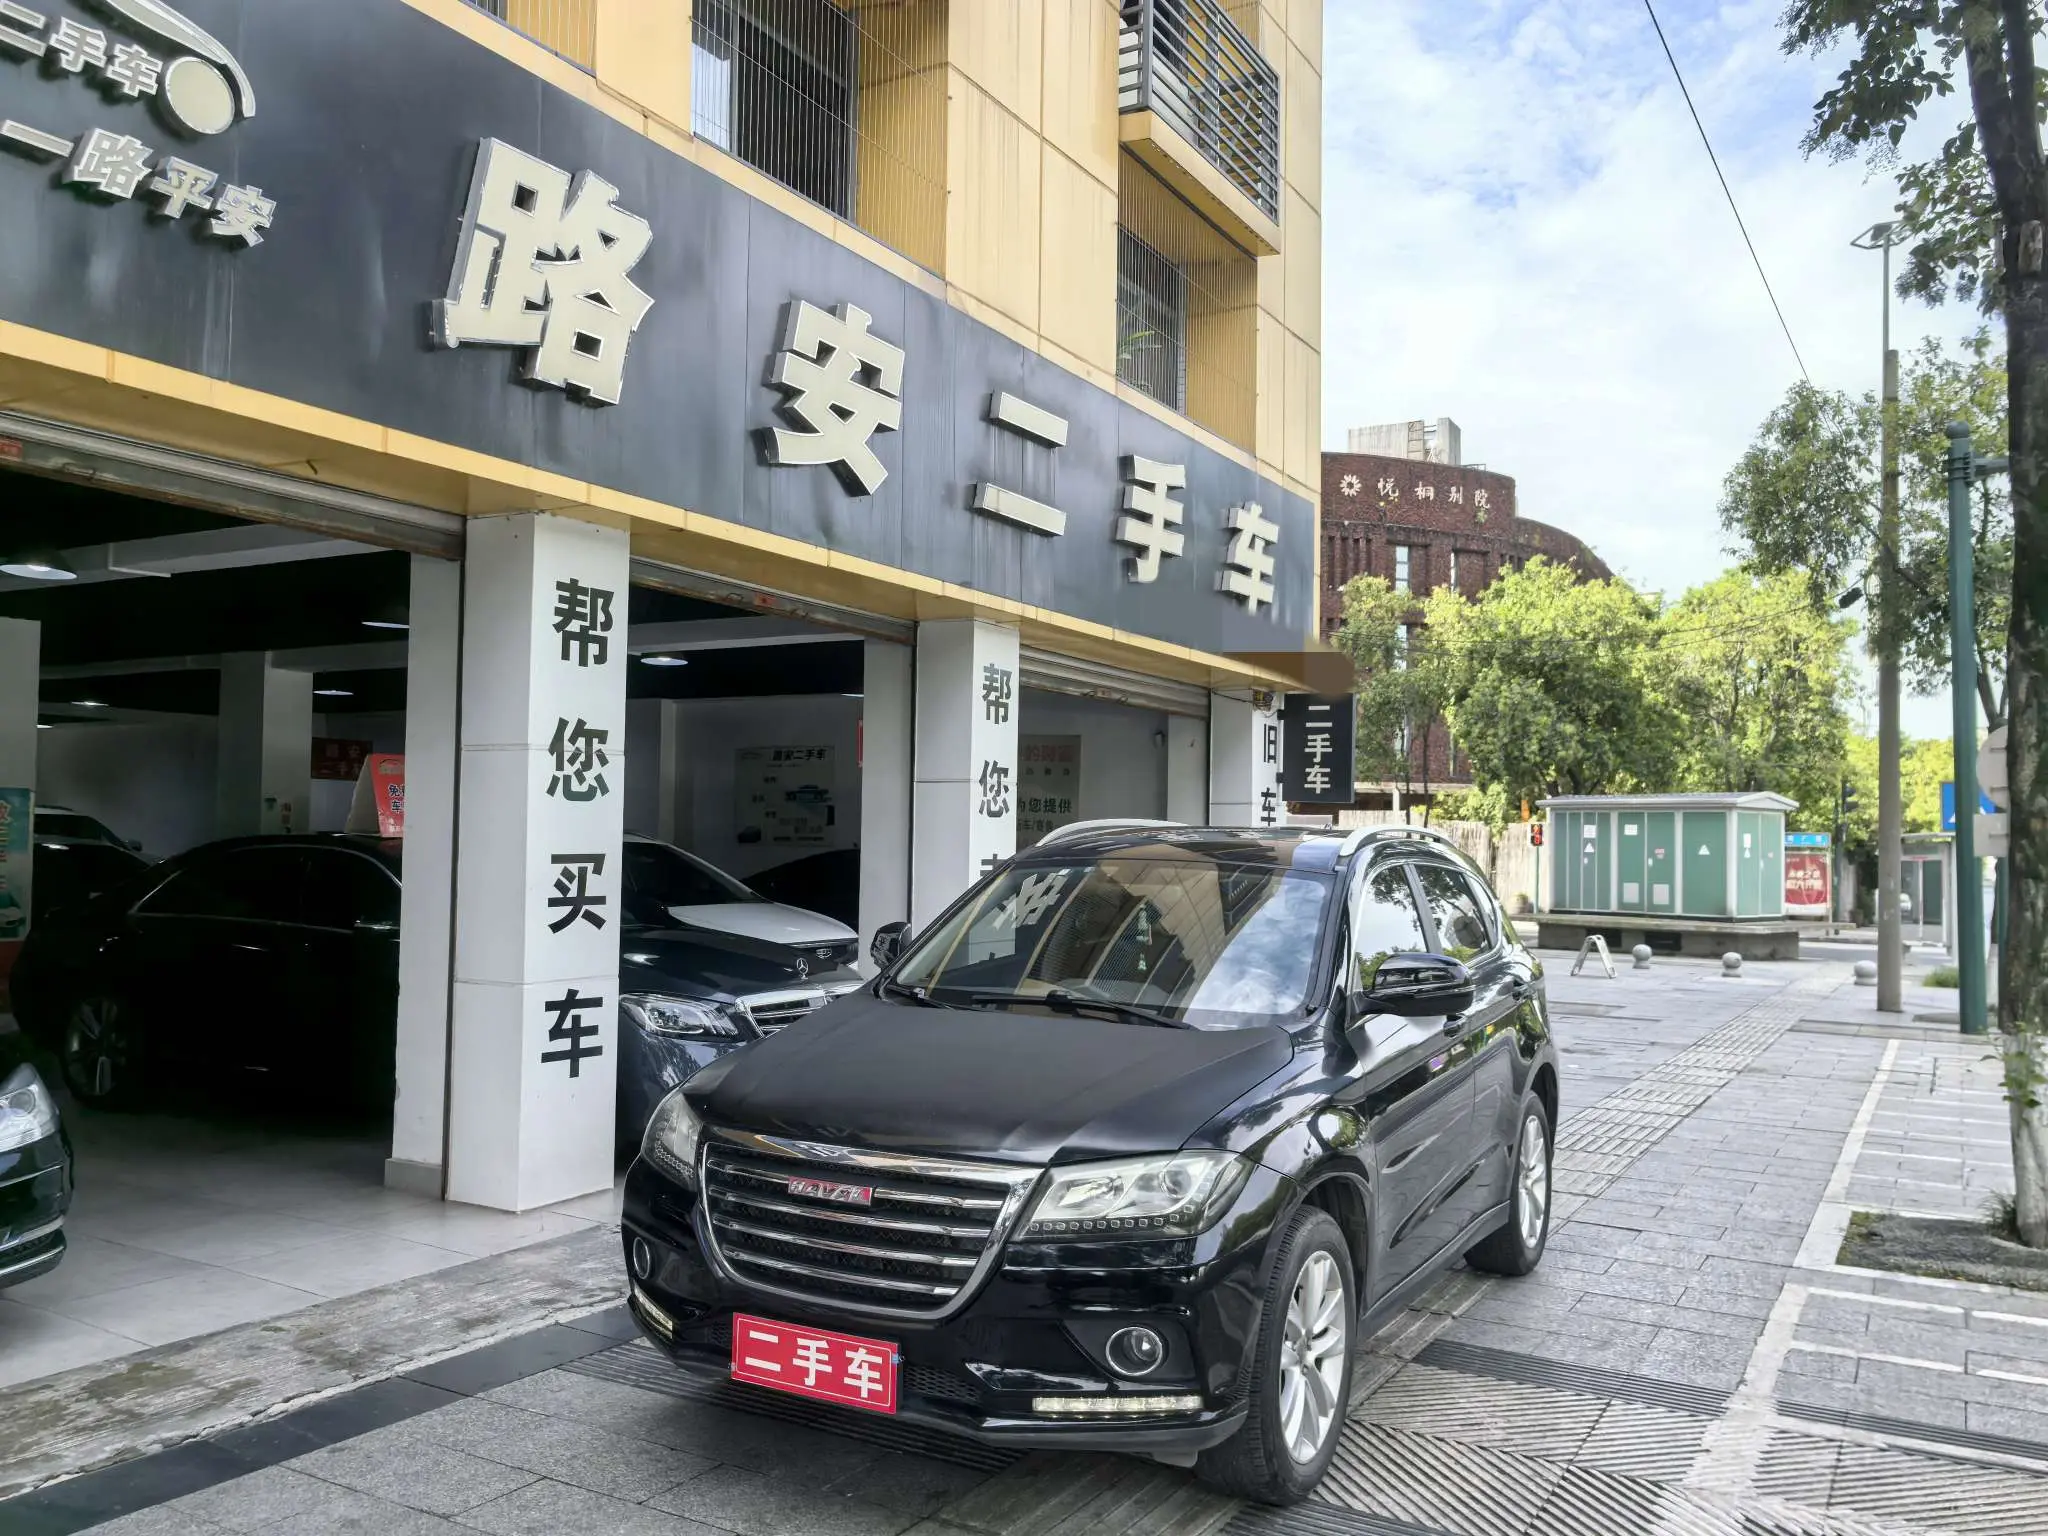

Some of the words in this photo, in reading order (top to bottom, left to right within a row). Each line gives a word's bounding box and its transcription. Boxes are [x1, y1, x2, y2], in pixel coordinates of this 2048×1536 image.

[0, 0, 163, 97] 二手车
[0, 119, 277, 248] 一路平安
[434, 136, 1280, 617] 路安二手车
[1377, 477, 1491, 510] 悦桐别院
[1303, 704, 1333, 795] 二手车
[540, 577, 615, 1079] 帮您买车
[744, 1329, 884, 1398] 二手车
